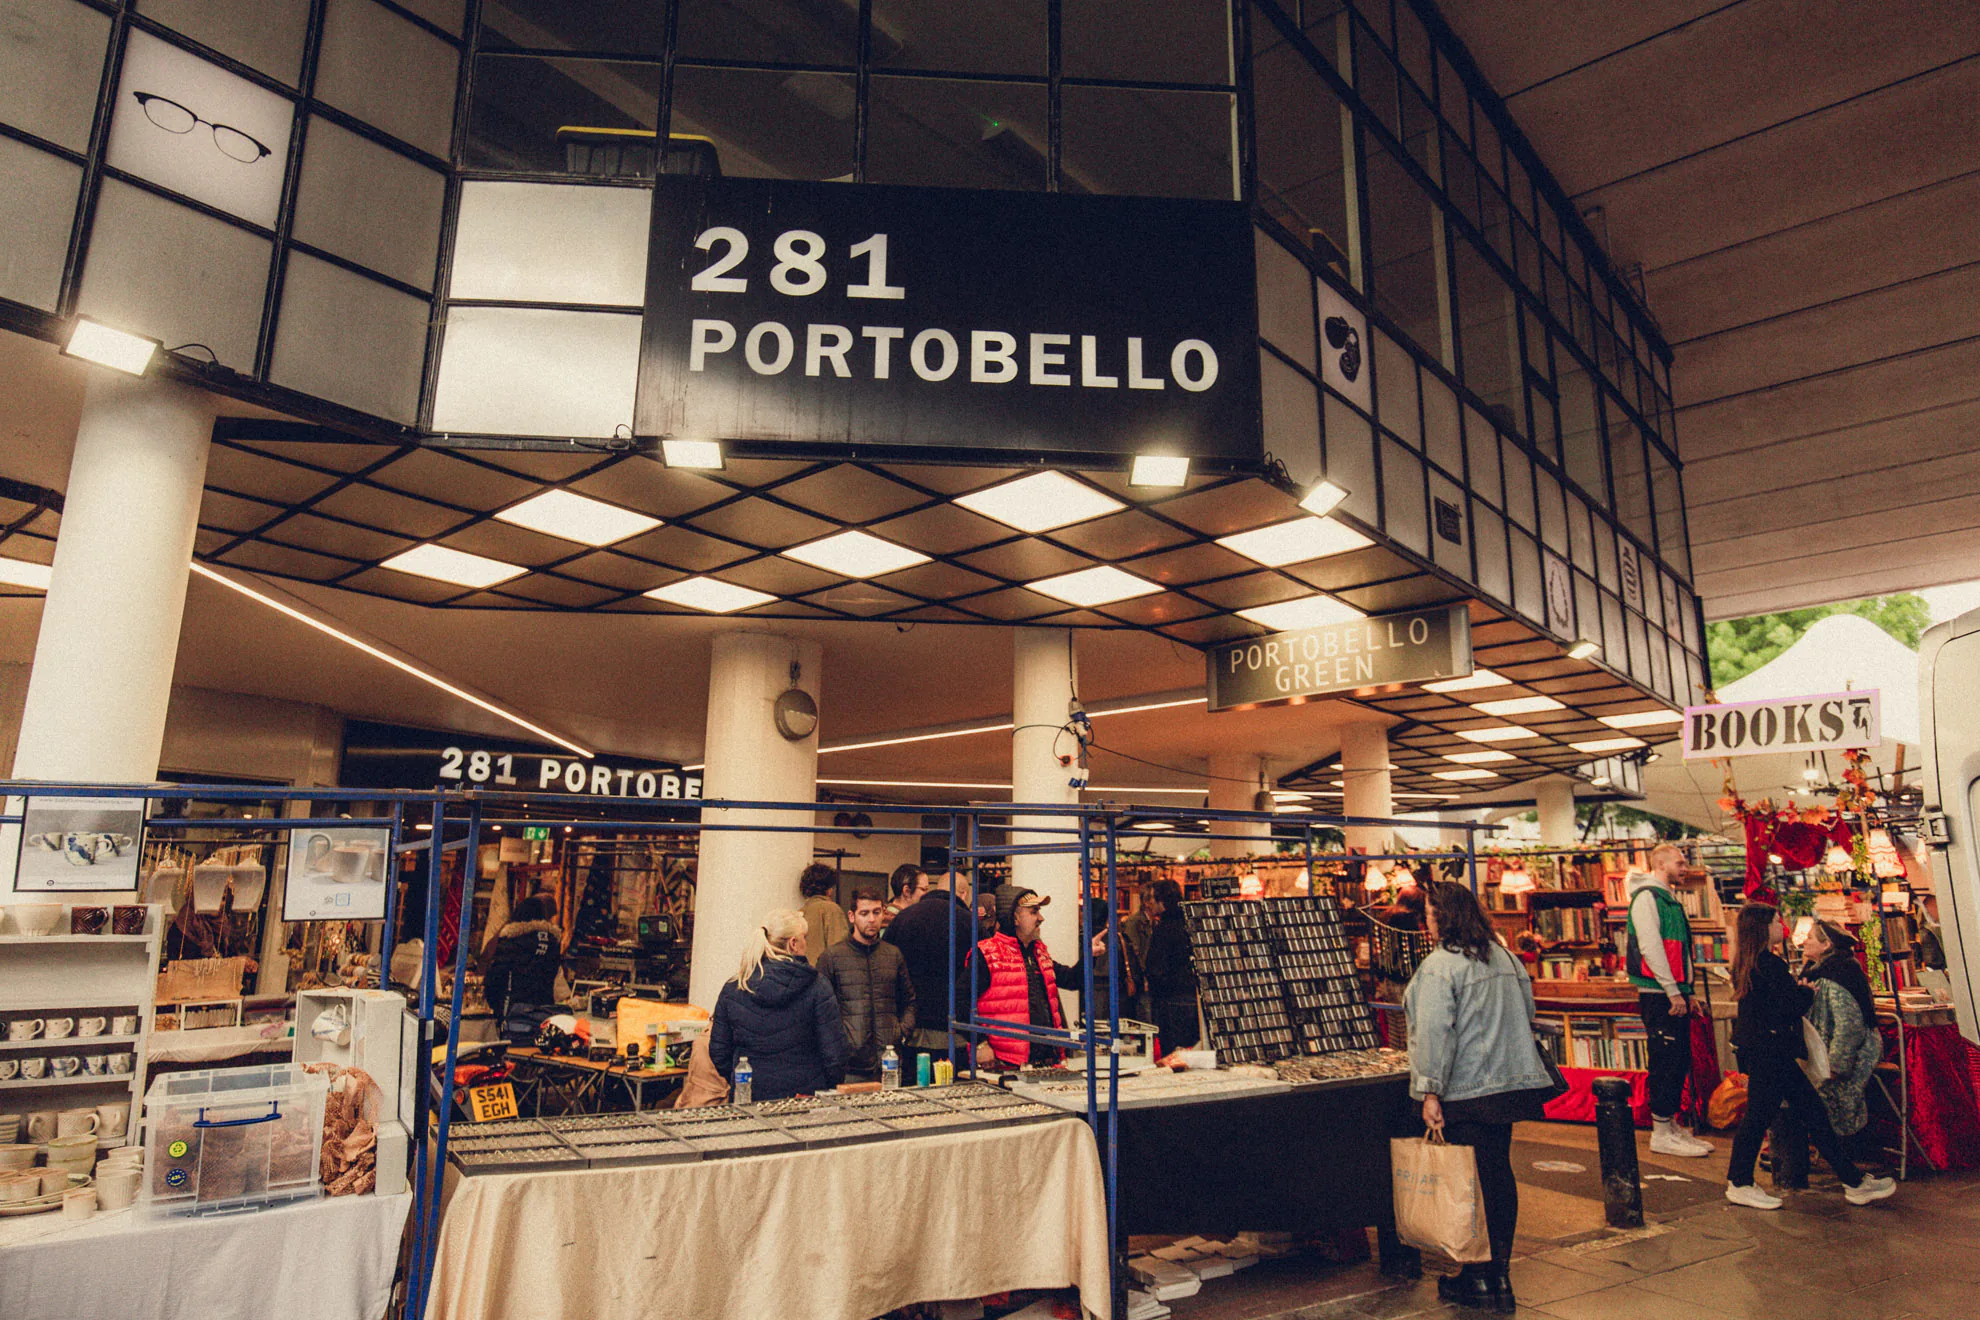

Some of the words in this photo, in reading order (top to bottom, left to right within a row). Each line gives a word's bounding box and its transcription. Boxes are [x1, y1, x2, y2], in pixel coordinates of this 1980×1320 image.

[691, 226, 905, 299] 281
[689, 318, 1219, 392] PORTOBELLO
[1231, 617, 1429, 674] PORTOBELLO
[1274, 653, 1374, 692] GREEN
[1690, 700, 1845, 751] BOOKS
[439, 747, 517, 785] 281
[476, 1086, 509, 1103] S541
[481, 1102, 511, 1118] EGH
